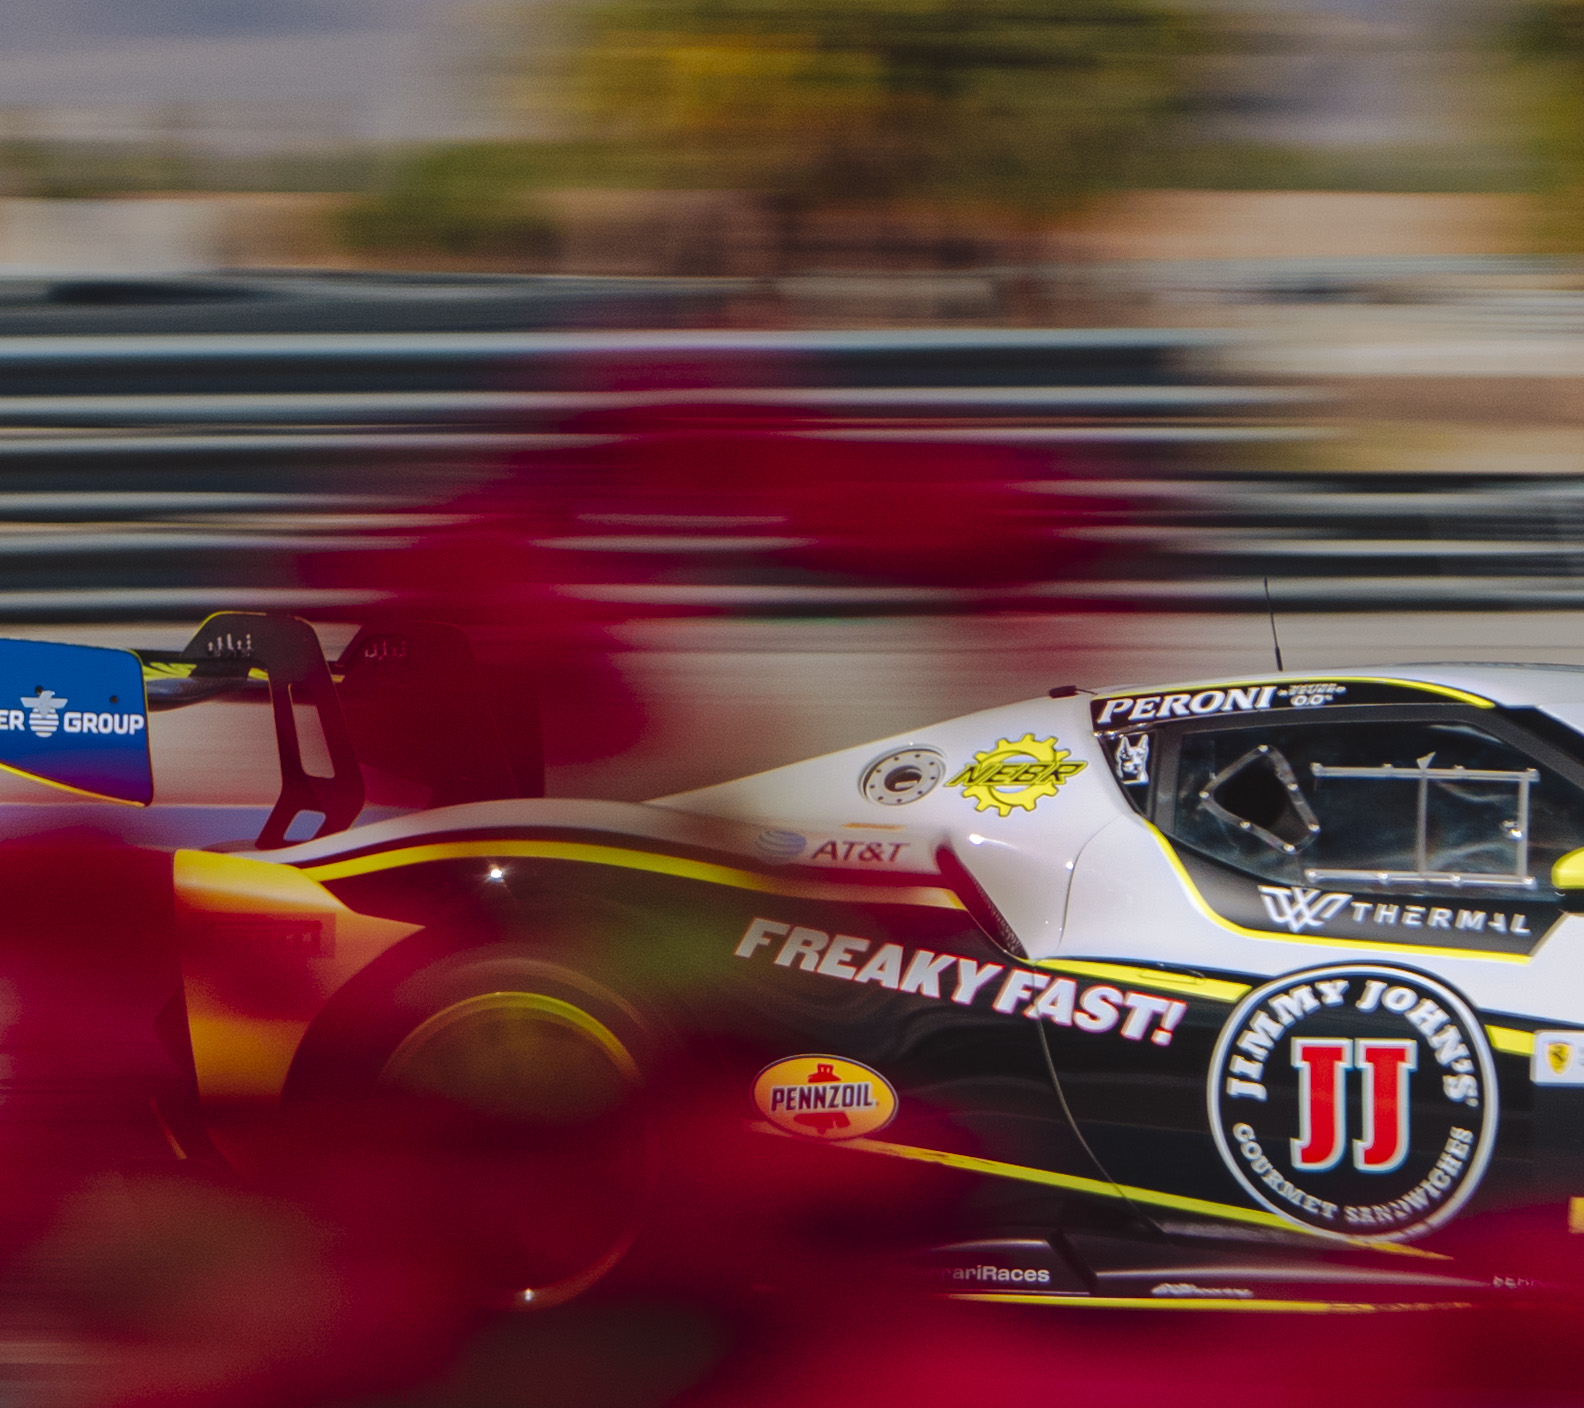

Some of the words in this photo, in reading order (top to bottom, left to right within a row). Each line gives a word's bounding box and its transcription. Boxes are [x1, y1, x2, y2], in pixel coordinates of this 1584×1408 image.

[63, 711, 144, 735] GROUP
[1097, 686, 1277, 724] PERONI
[811, 840, 910, 862] AT&T
[1351, 902, 1531, 934] THERMAL
[734, 918, 1004, 1004] FREAKY
[993, 969, 1187, 1045] FAST!
[1226, 980, 1349, 1102] JIMMY
[771, 1084, 873, 1111] PENNZOIL
[1290, 1037, 1418, 1173] JJ
[1232, 1122, 1339, 1219] GOURMET
[1344, 1126, 1474, 1224] SANDWICHES
